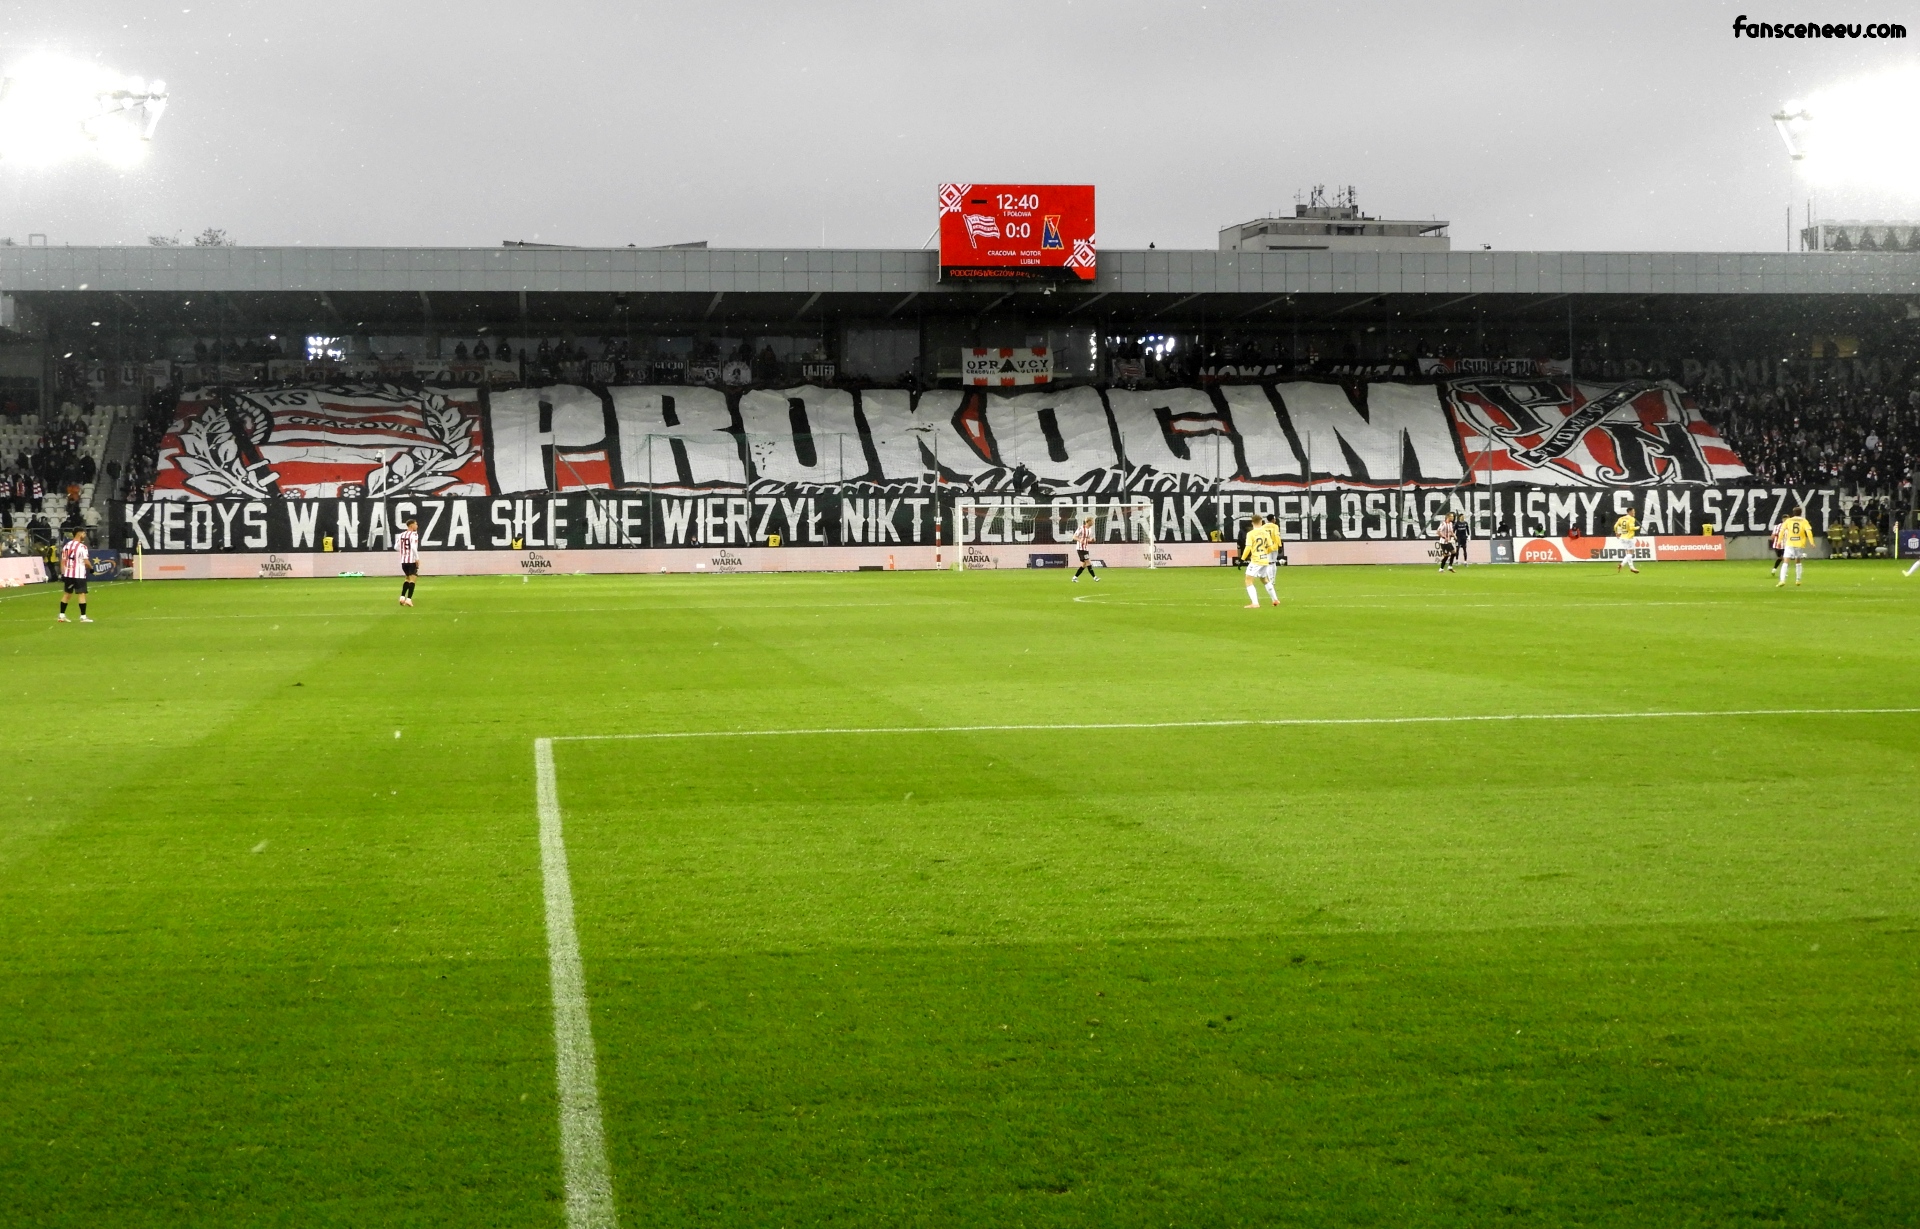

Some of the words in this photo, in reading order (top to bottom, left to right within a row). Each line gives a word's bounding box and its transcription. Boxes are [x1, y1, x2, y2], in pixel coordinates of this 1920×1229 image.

[996, 194, 1039, 210] 12:40
[1005, 222, 1031, 238] 0:0
[264, 392, 309, 407] KS
[288, 416, 420, 435] CRACOVIA
[489, 383, 1465, 494] PROKOCIM
[287, 501, 319, 549] W
[585, 499, 643, 546] NIE
[661, 497, 826, 545] WIERZYŁ
[839, 497, 930, 543] NIKT
[1702, 488, 1836, 535] SZCZYT
[1792, 522, 1800, 535] 6
[1525, 547, 1557, 561] PPOŻ.
[1590, 548, 1651, 559] SUPOER
[1657, 543, 1722, 553] sklep.cracovia.pl
[96, 562, 112, 572] LOTTO
[261, 563, 293, 572] WARKA
[520, 560, 552, 568] WARKA
[711, 558, 743, 566] WARKA
